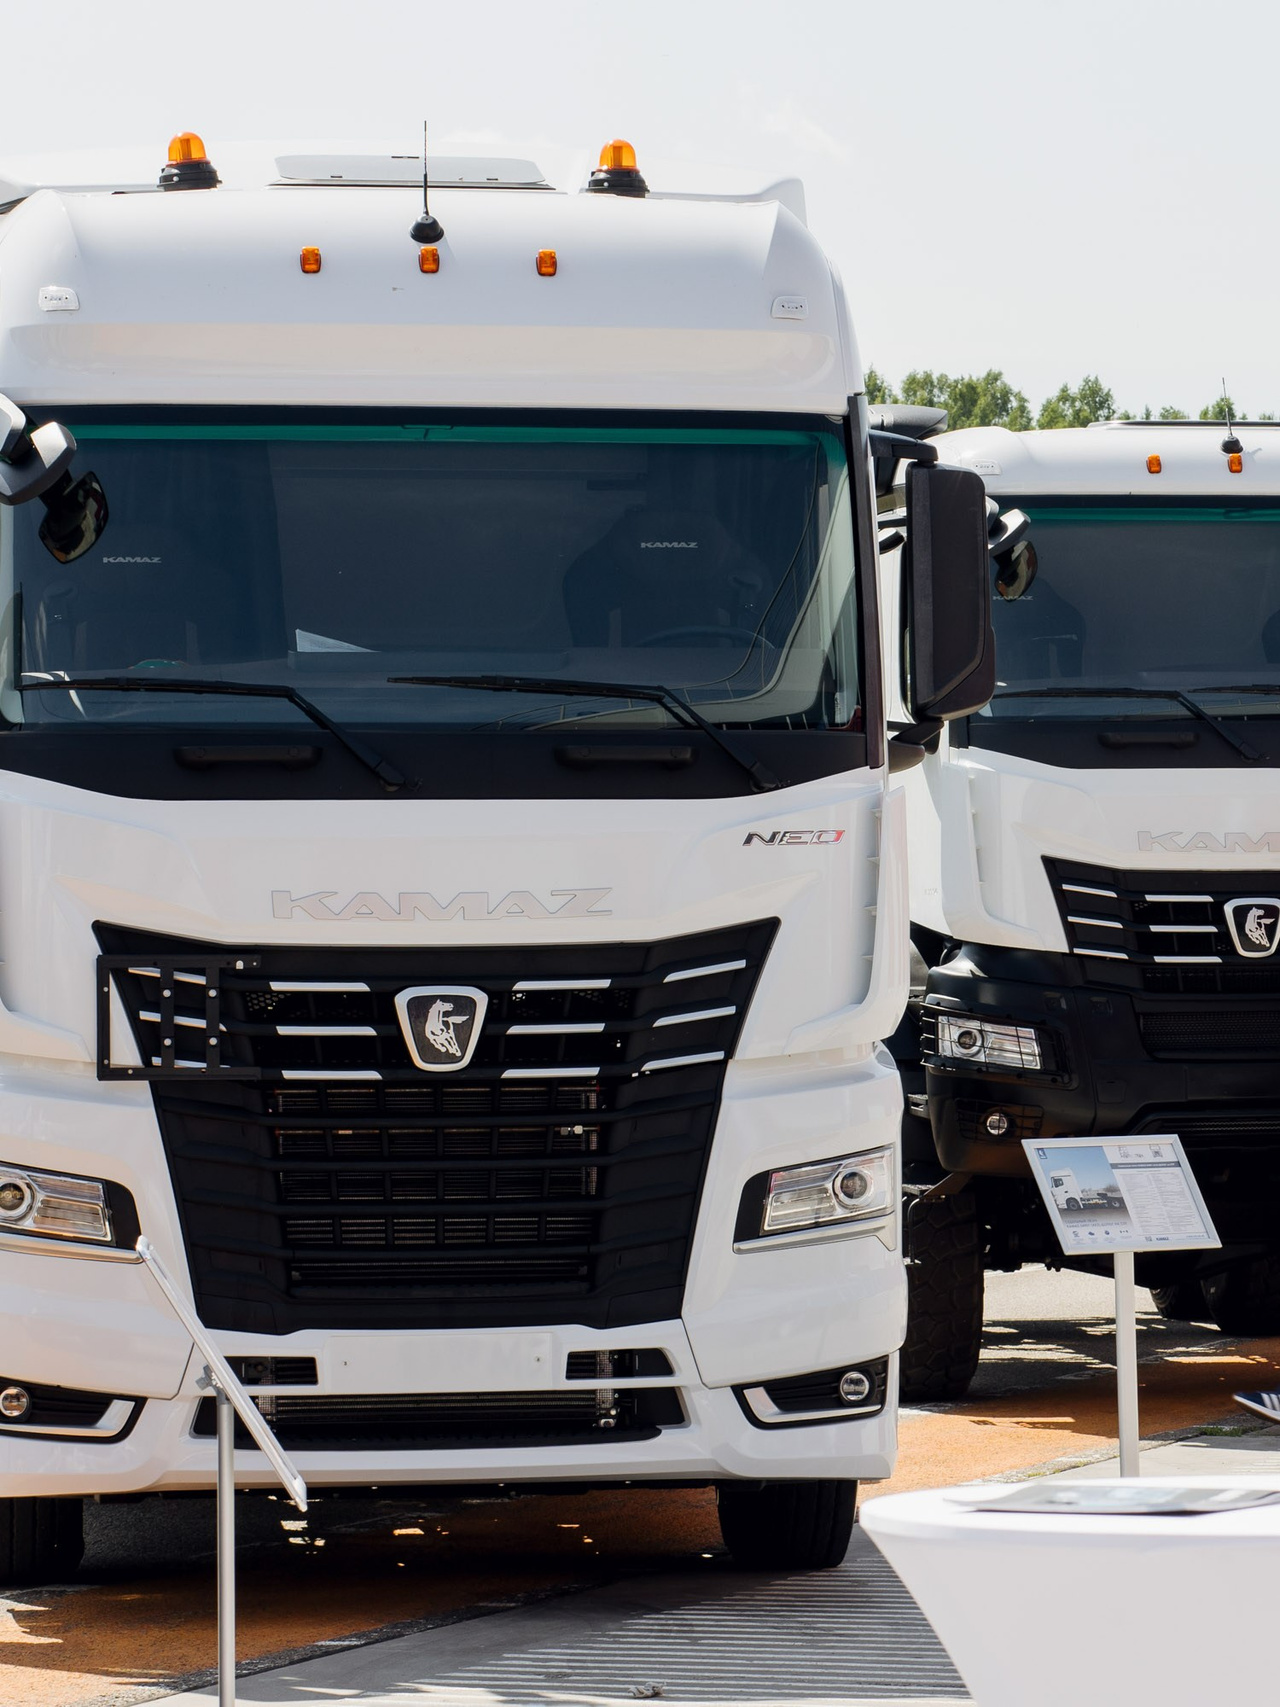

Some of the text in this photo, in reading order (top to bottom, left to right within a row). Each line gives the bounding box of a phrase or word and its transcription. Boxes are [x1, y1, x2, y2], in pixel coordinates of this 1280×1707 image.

[641, 541, 699, 549] KAMAZ
[102, 556, 162, 564] KAMAZ
[742, 829, 846, 847] NEO
[271, 887, 613, 921] KAMAZ
